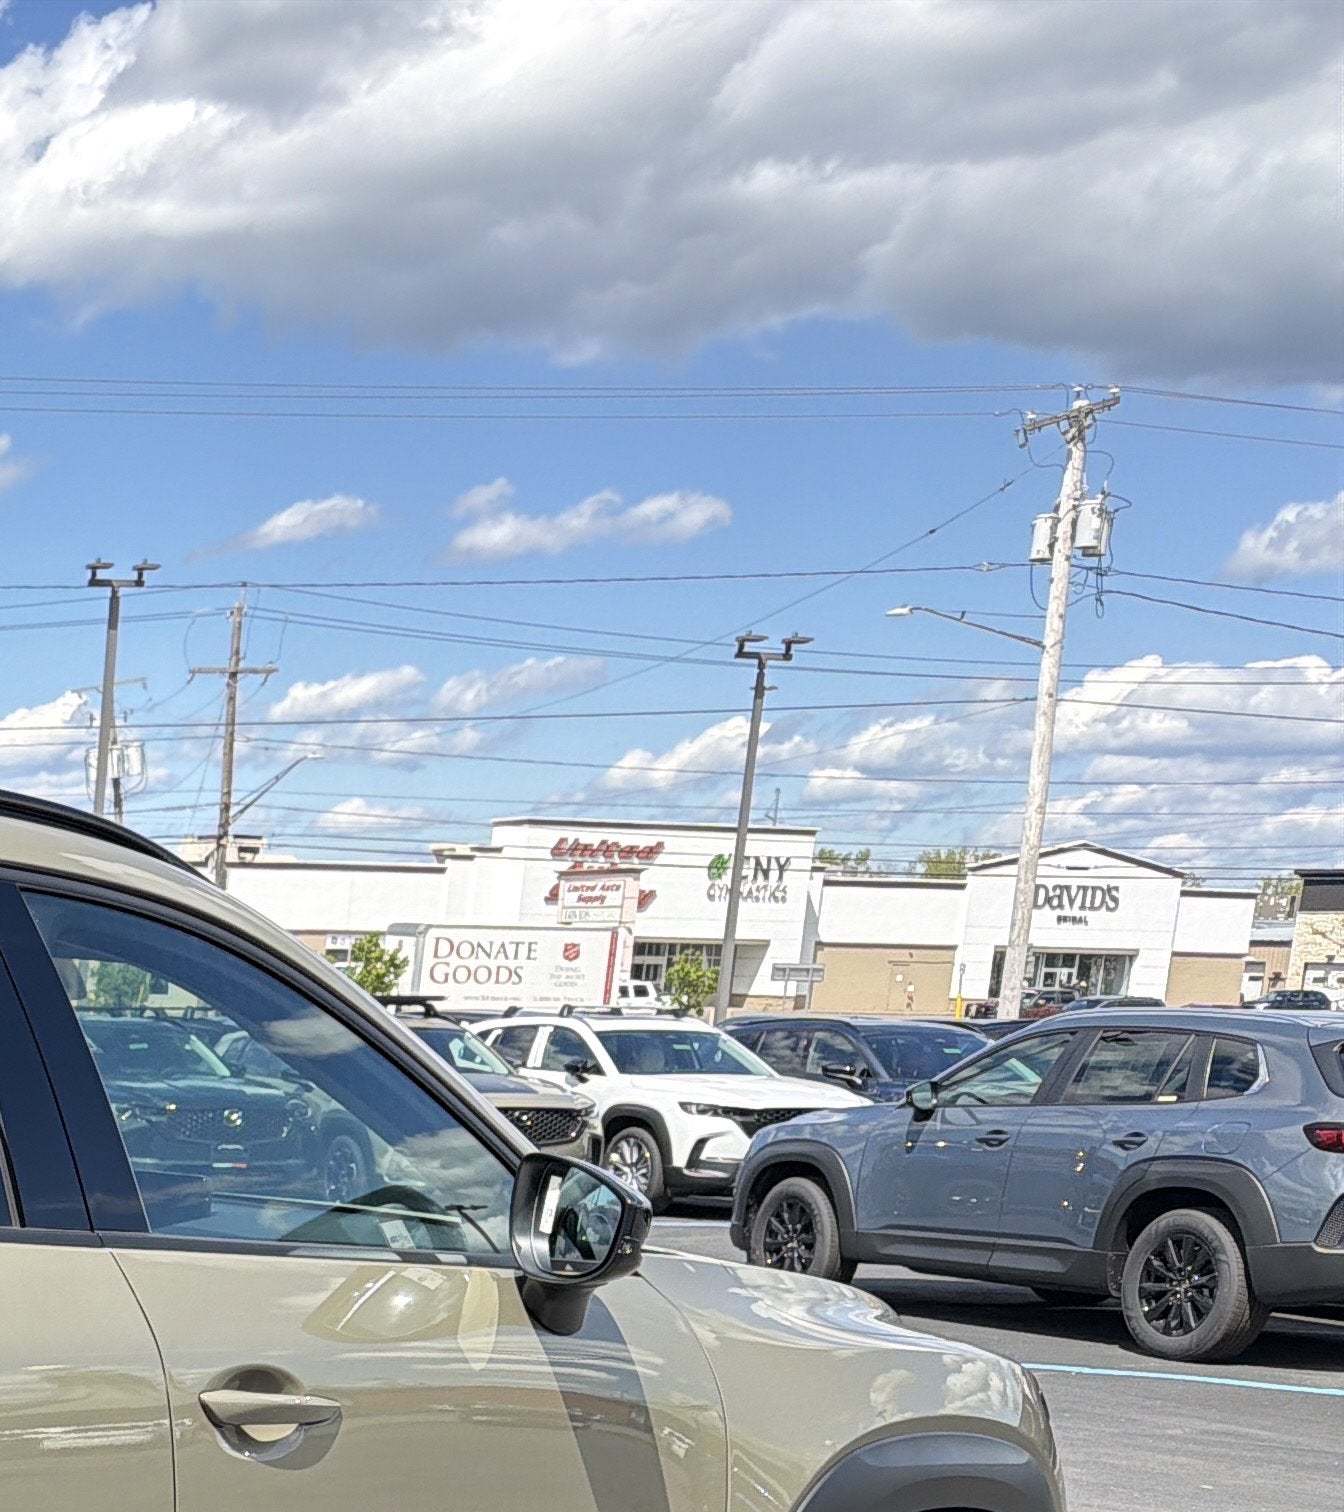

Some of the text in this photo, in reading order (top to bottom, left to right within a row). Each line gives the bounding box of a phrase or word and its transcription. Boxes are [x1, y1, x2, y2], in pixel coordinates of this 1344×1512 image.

[550, 837, 665, 861] United
[432, 936, 539, 962] DONATE
[429, 961, 524, 986] GOODS
